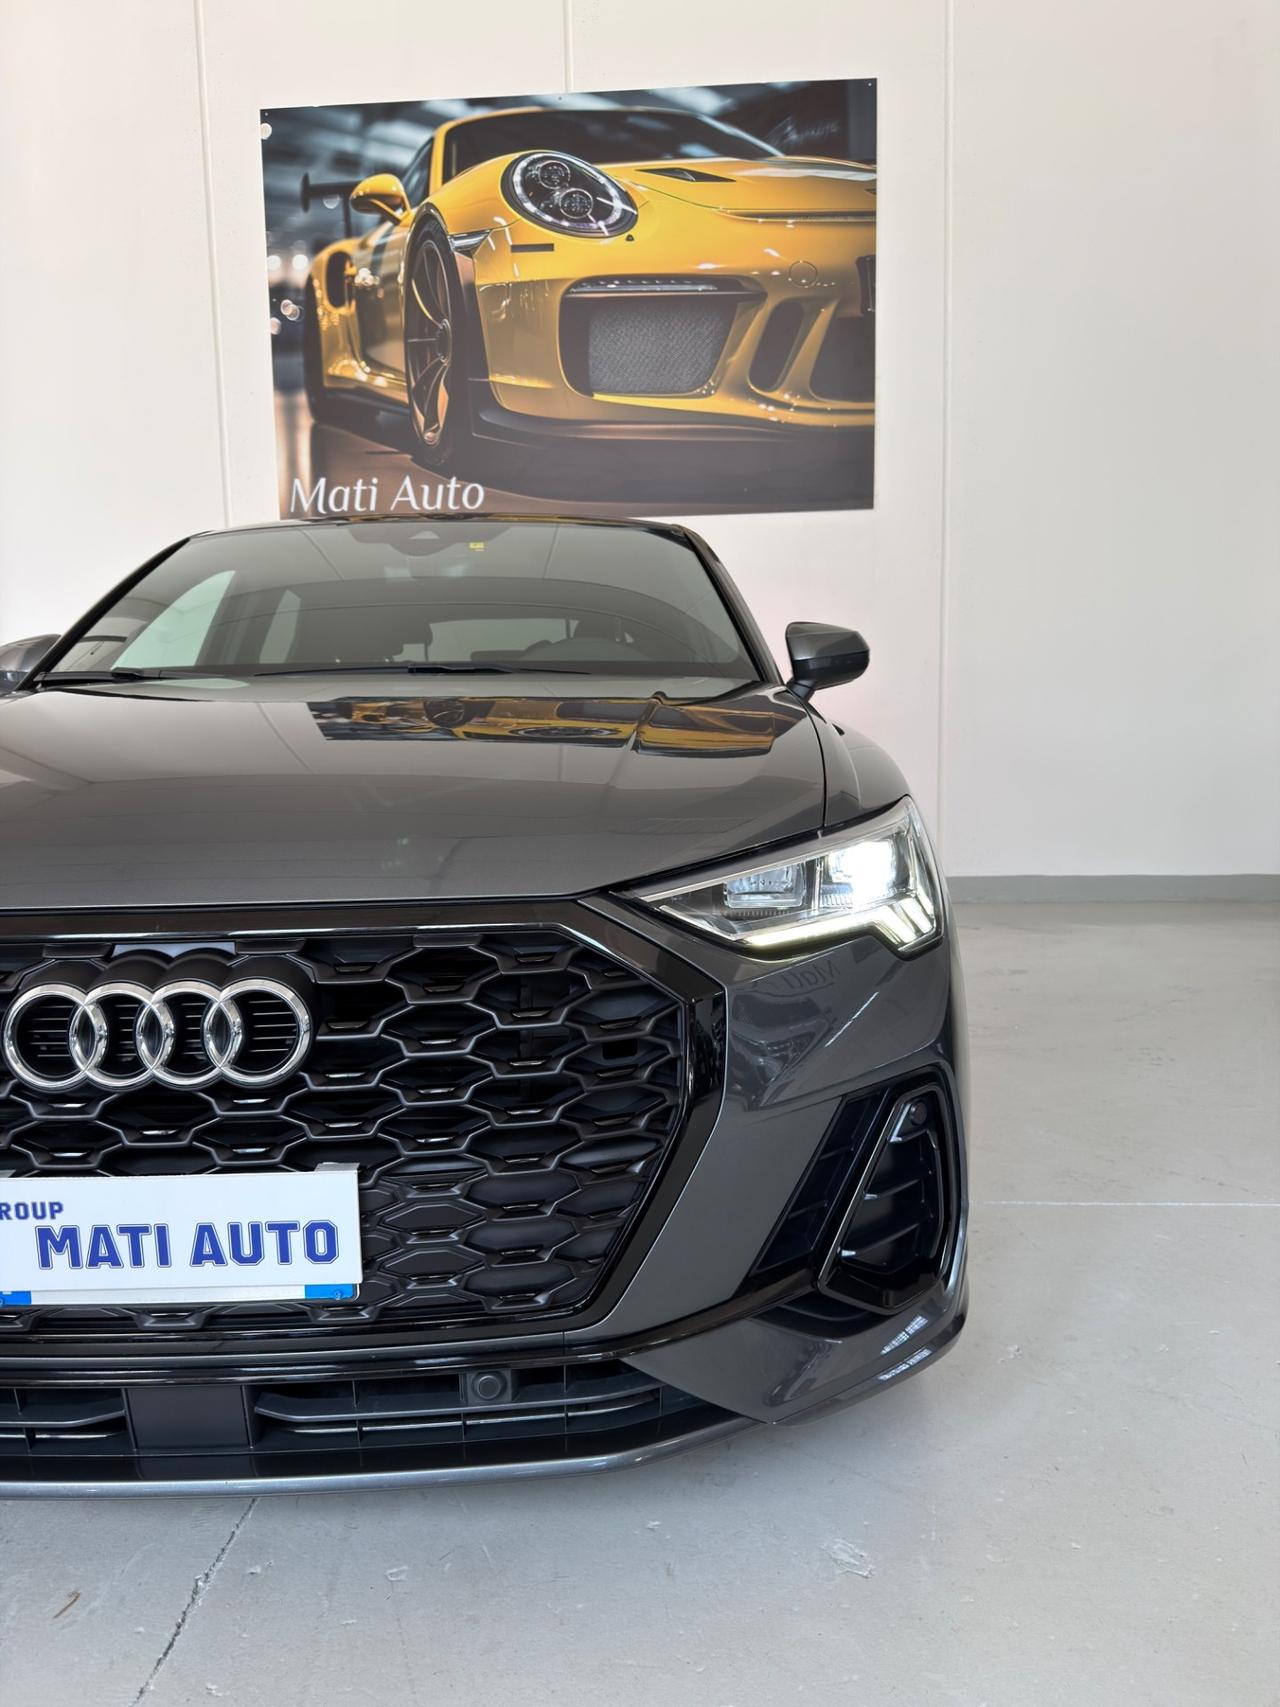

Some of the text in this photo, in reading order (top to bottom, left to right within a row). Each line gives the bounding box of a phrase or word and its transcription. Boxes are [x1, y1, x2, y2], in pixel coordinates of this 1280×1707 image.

[290, 474, 485, 514] Mati Auto
[35, 1219, 339, 1270] MATI AUTO
